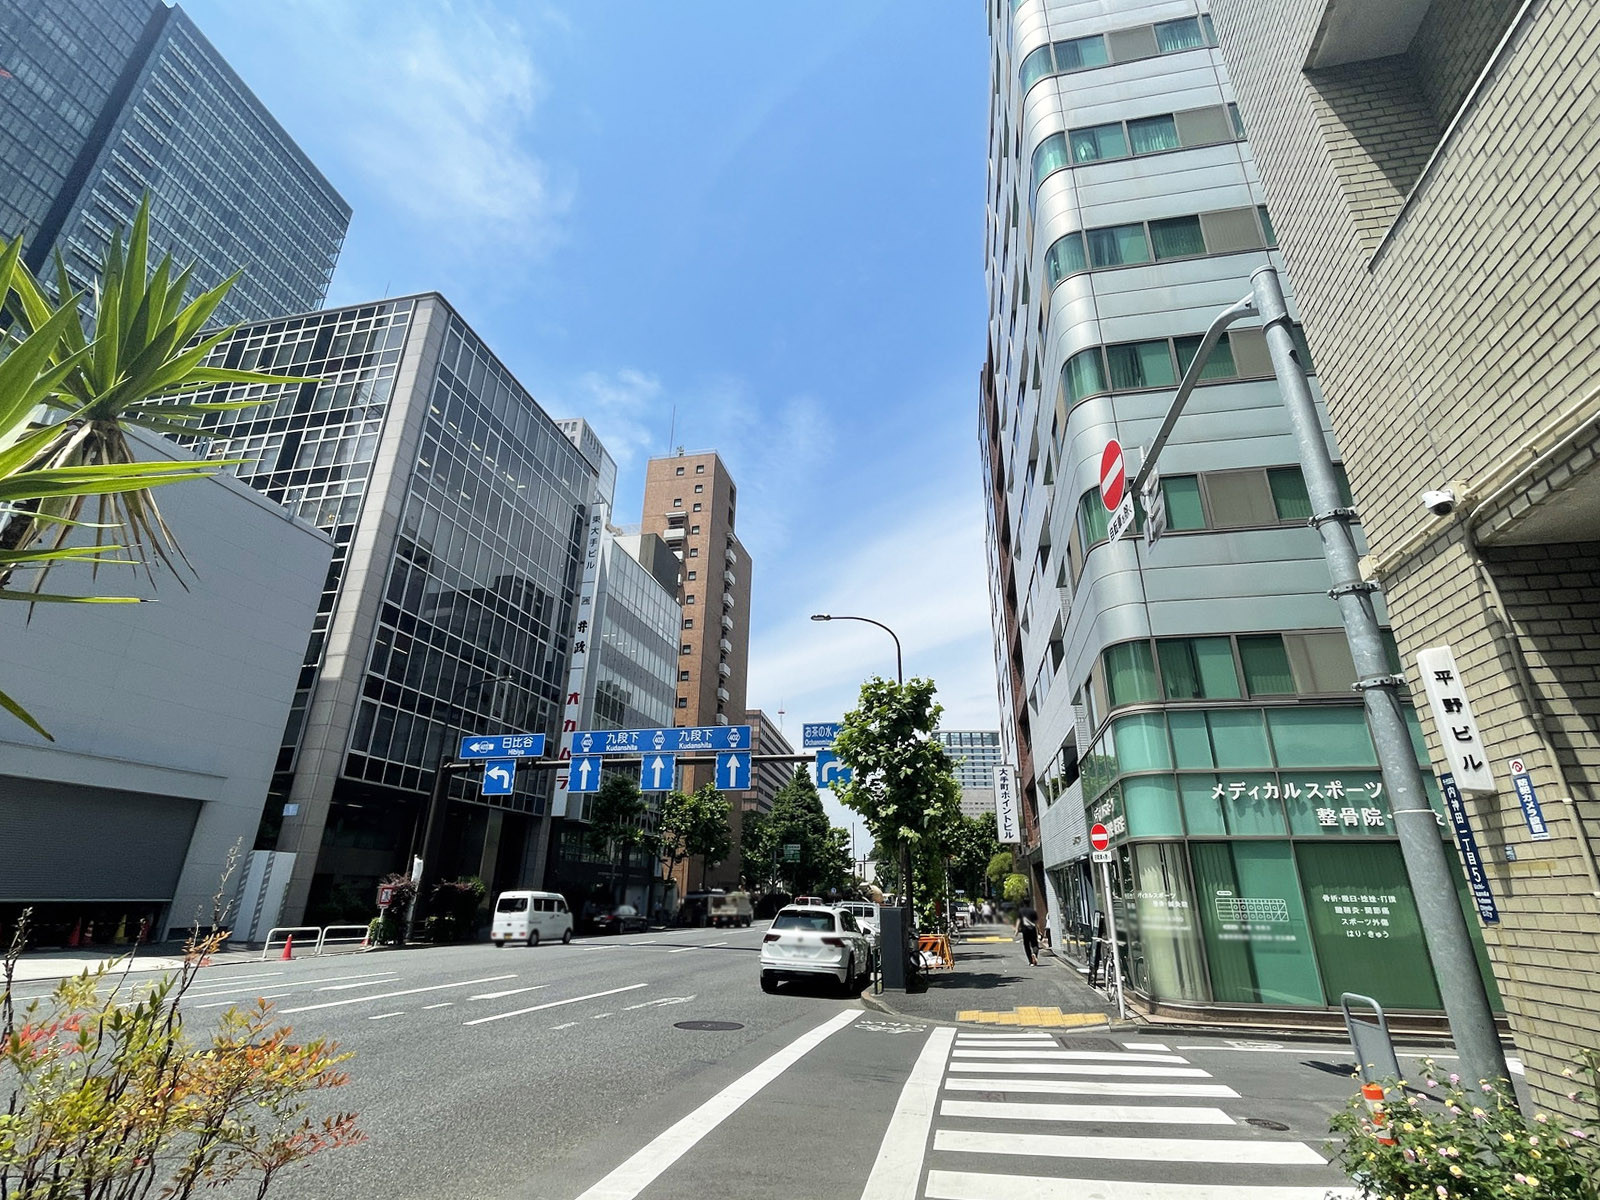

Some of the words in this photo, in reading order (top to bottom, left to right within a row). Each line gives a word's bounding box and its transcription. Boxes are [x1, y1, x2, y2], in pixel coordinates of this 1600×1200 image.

[573, 620, 588, 654] 井政
[1434, 670, 1483, 771] 平野ビル
[605, 732, 640, 744] 九段下
[678, 729, 714, 742] 九段下
[804, 725, 833, 738] お茶の水
[502, 736, 534, 749] 日比谷
[556, 692, 580, 790] オカムラ
[507, 748, 525, 756] Hibiya
[605, 744, 638, 752] Kudanshita
[1211, 780, 1382, 800] メディカルスポーツ
[1341, 918, 1389, 926] スポーツ外傷
[1346, 930, 1390, 938] はり・きゅう
